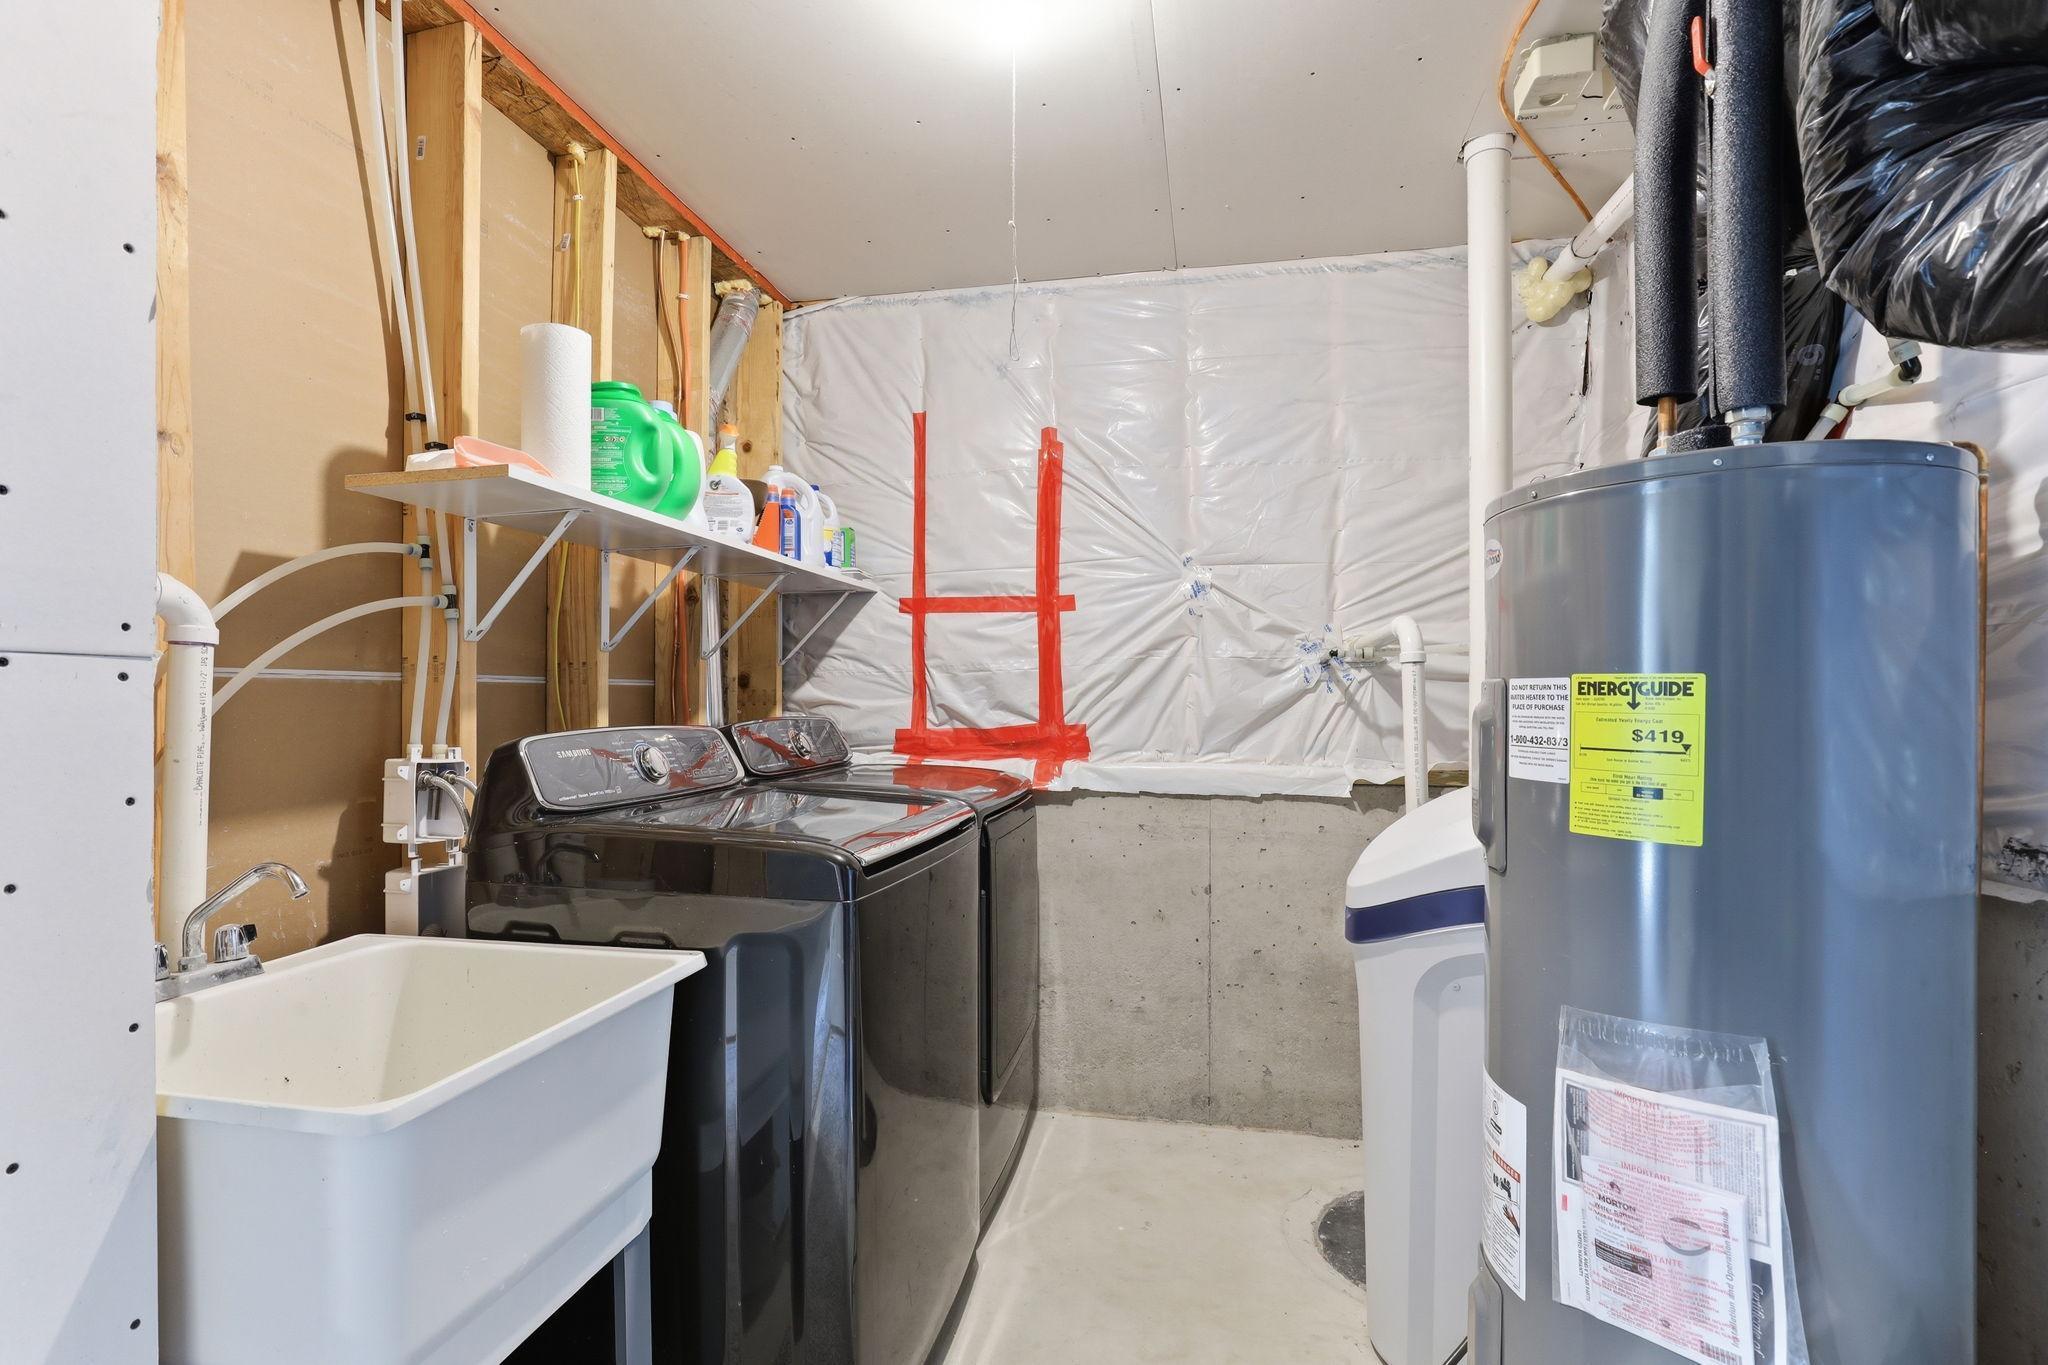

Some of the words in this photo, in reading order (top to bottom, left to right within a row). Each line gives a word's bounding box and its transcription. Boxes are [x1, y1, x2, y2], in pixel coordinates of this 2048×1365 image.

[1577, 681, 1695, 697] ENERGYGUIDE
[1632, 729, 1685, 744] $419
[196, 745, 205, 759] PIPE
[556, 748, 592, 759] SAMSUNG
[1621, 1161, 1671, 1183] IMPORTANT
[1598, 1193, 1636, 1213] MORTON
[1724, 1240, 1735, 1282] Operation
[1726, 1283, 1736, 1300] and
[1752, 1284, 1765, 1339] Certificate
[1753, 1341, 1765, 1358] of
